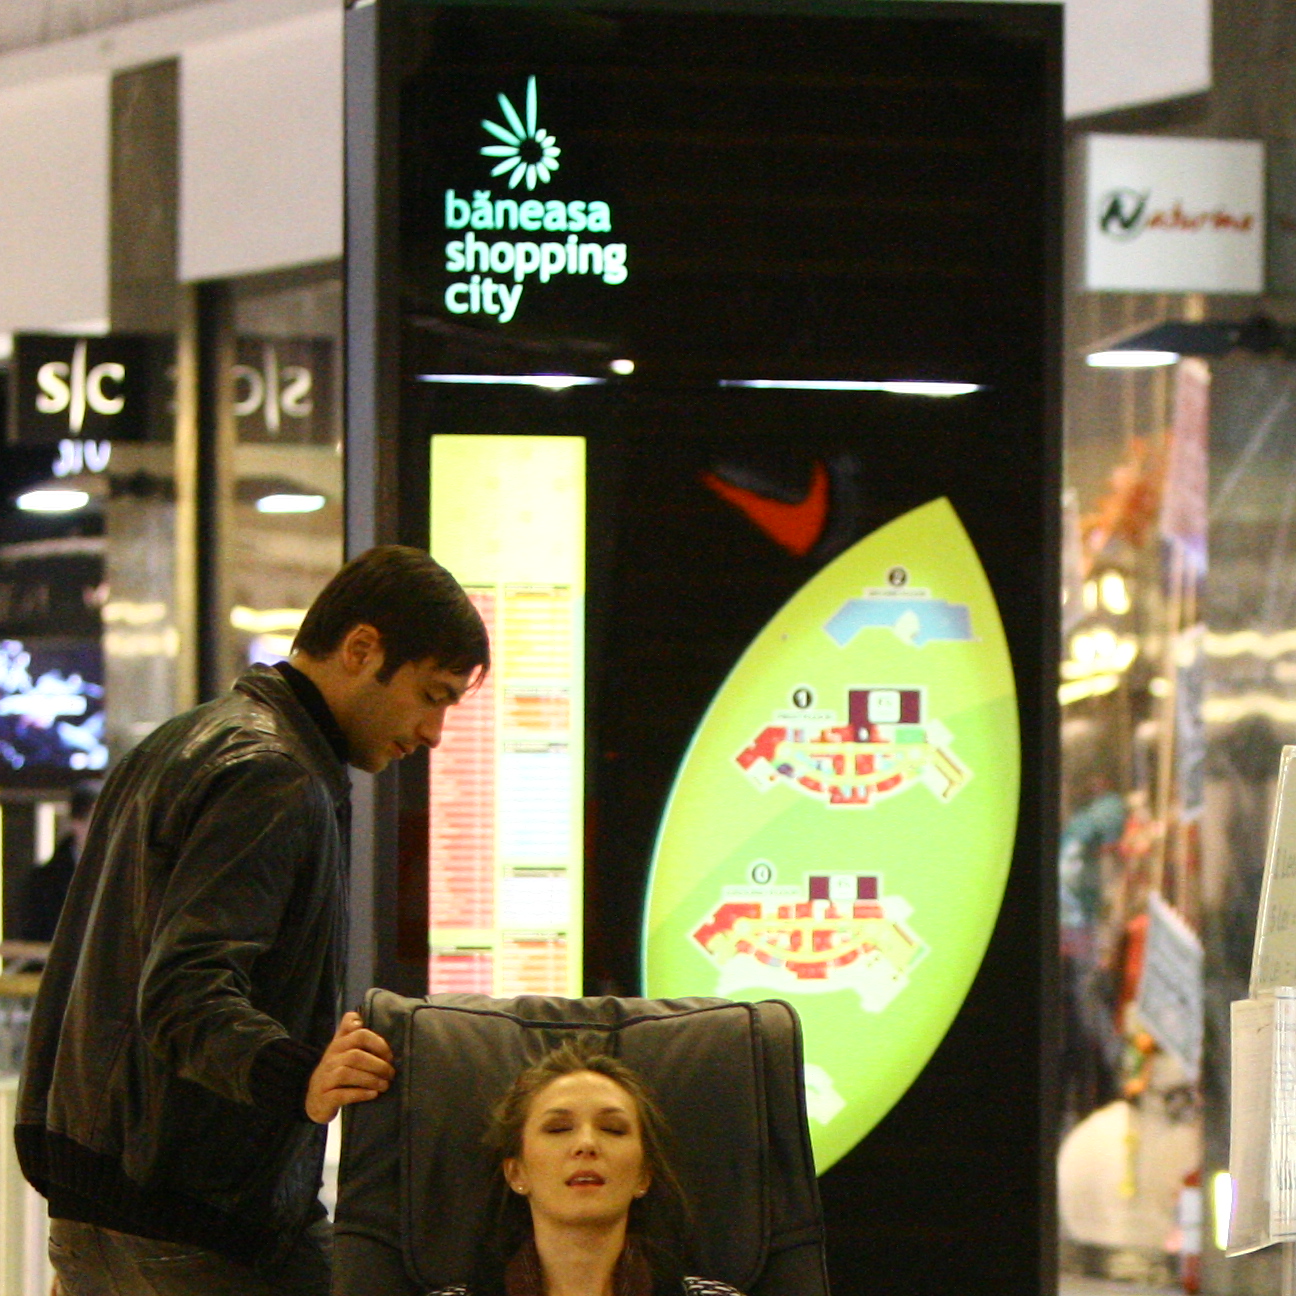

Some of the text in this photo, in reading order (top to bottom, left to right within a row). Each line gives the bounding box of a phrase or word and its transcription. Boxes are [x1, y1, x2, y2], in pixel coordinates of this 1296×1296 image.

[445, 189, 612, 233] băneasa
[445, 233, 628, 285] shopping
[445, 276, 523, 323] city
